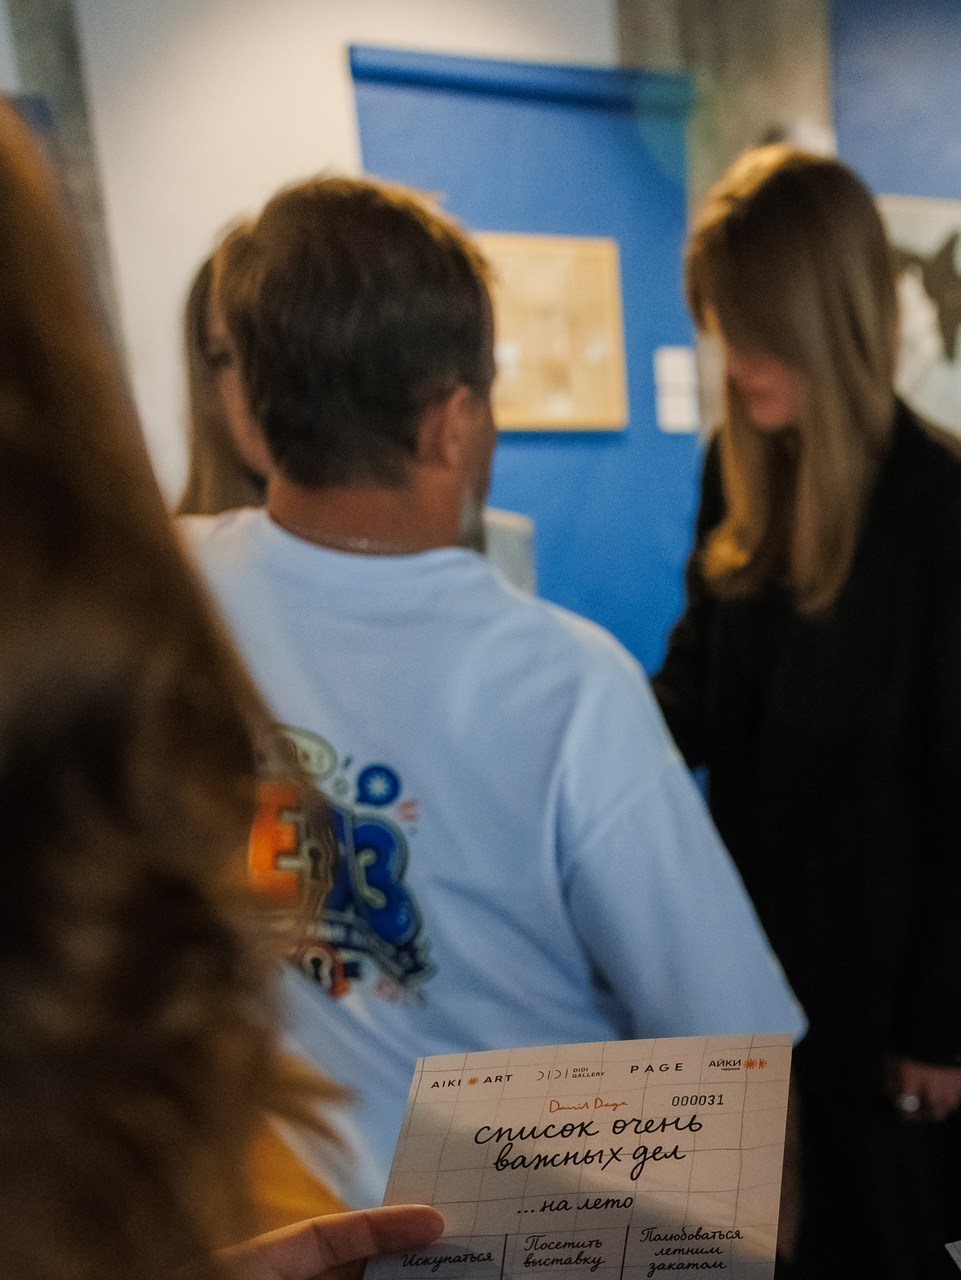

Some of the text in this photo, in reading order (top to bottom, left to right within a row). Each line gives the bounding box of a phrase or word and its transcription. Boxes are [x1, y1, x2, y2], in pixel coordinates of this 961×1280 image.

[630, 1062, 683, 1073] PAGE
[708, 1058, 741, 1067] АЙКИ
[431, 1074, 513, 1089] AIKI ART
[671, 1094, 724, 1107] 000031
[474, 1115, 703, 1144] список очень
[493, 1142, 686, 1181] важных дел
[577, 1196, 633, 1211] лето
[524, 1234, 603, 1251] Посетить
[640, 1227, 744, 1243] Полюбоваться
[655, 1246, 723, 1256] летним
[401, 1252, 495, 1272] Искупаться
[524, 1251, 606, 1272] выставку
[647, 1260, 727, 1278] закатом
